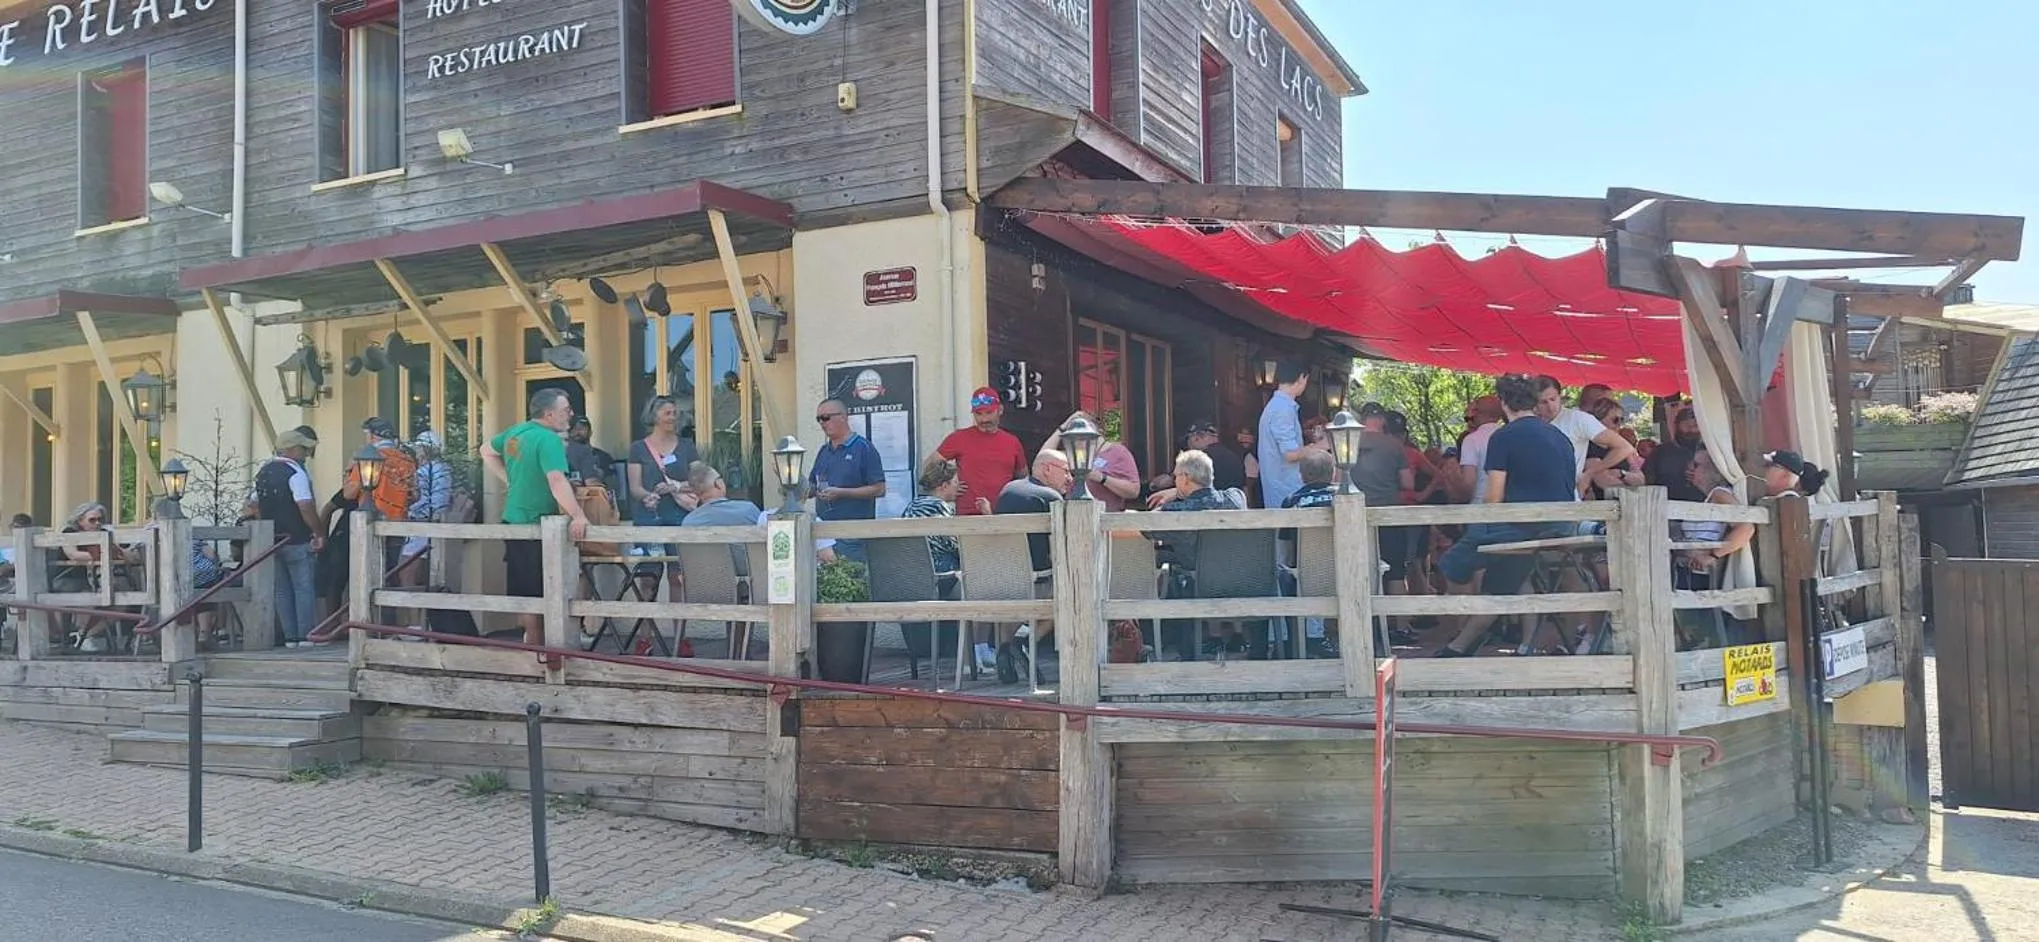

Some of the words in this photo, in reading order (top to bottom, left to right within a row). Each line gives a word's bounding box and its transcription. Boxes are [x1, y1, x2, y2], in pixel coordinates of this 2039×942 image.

[44, 0, 215, 55] RELA
[427, 22, 588, 79] RESTAURANT
[1281, 46, 1323, 121] LACS
[853, 403, 903, 414] BISTROT
[1728, 644, 1771, 659] RELAIS
[1730, 655, 1772, 676] MOTARDS
